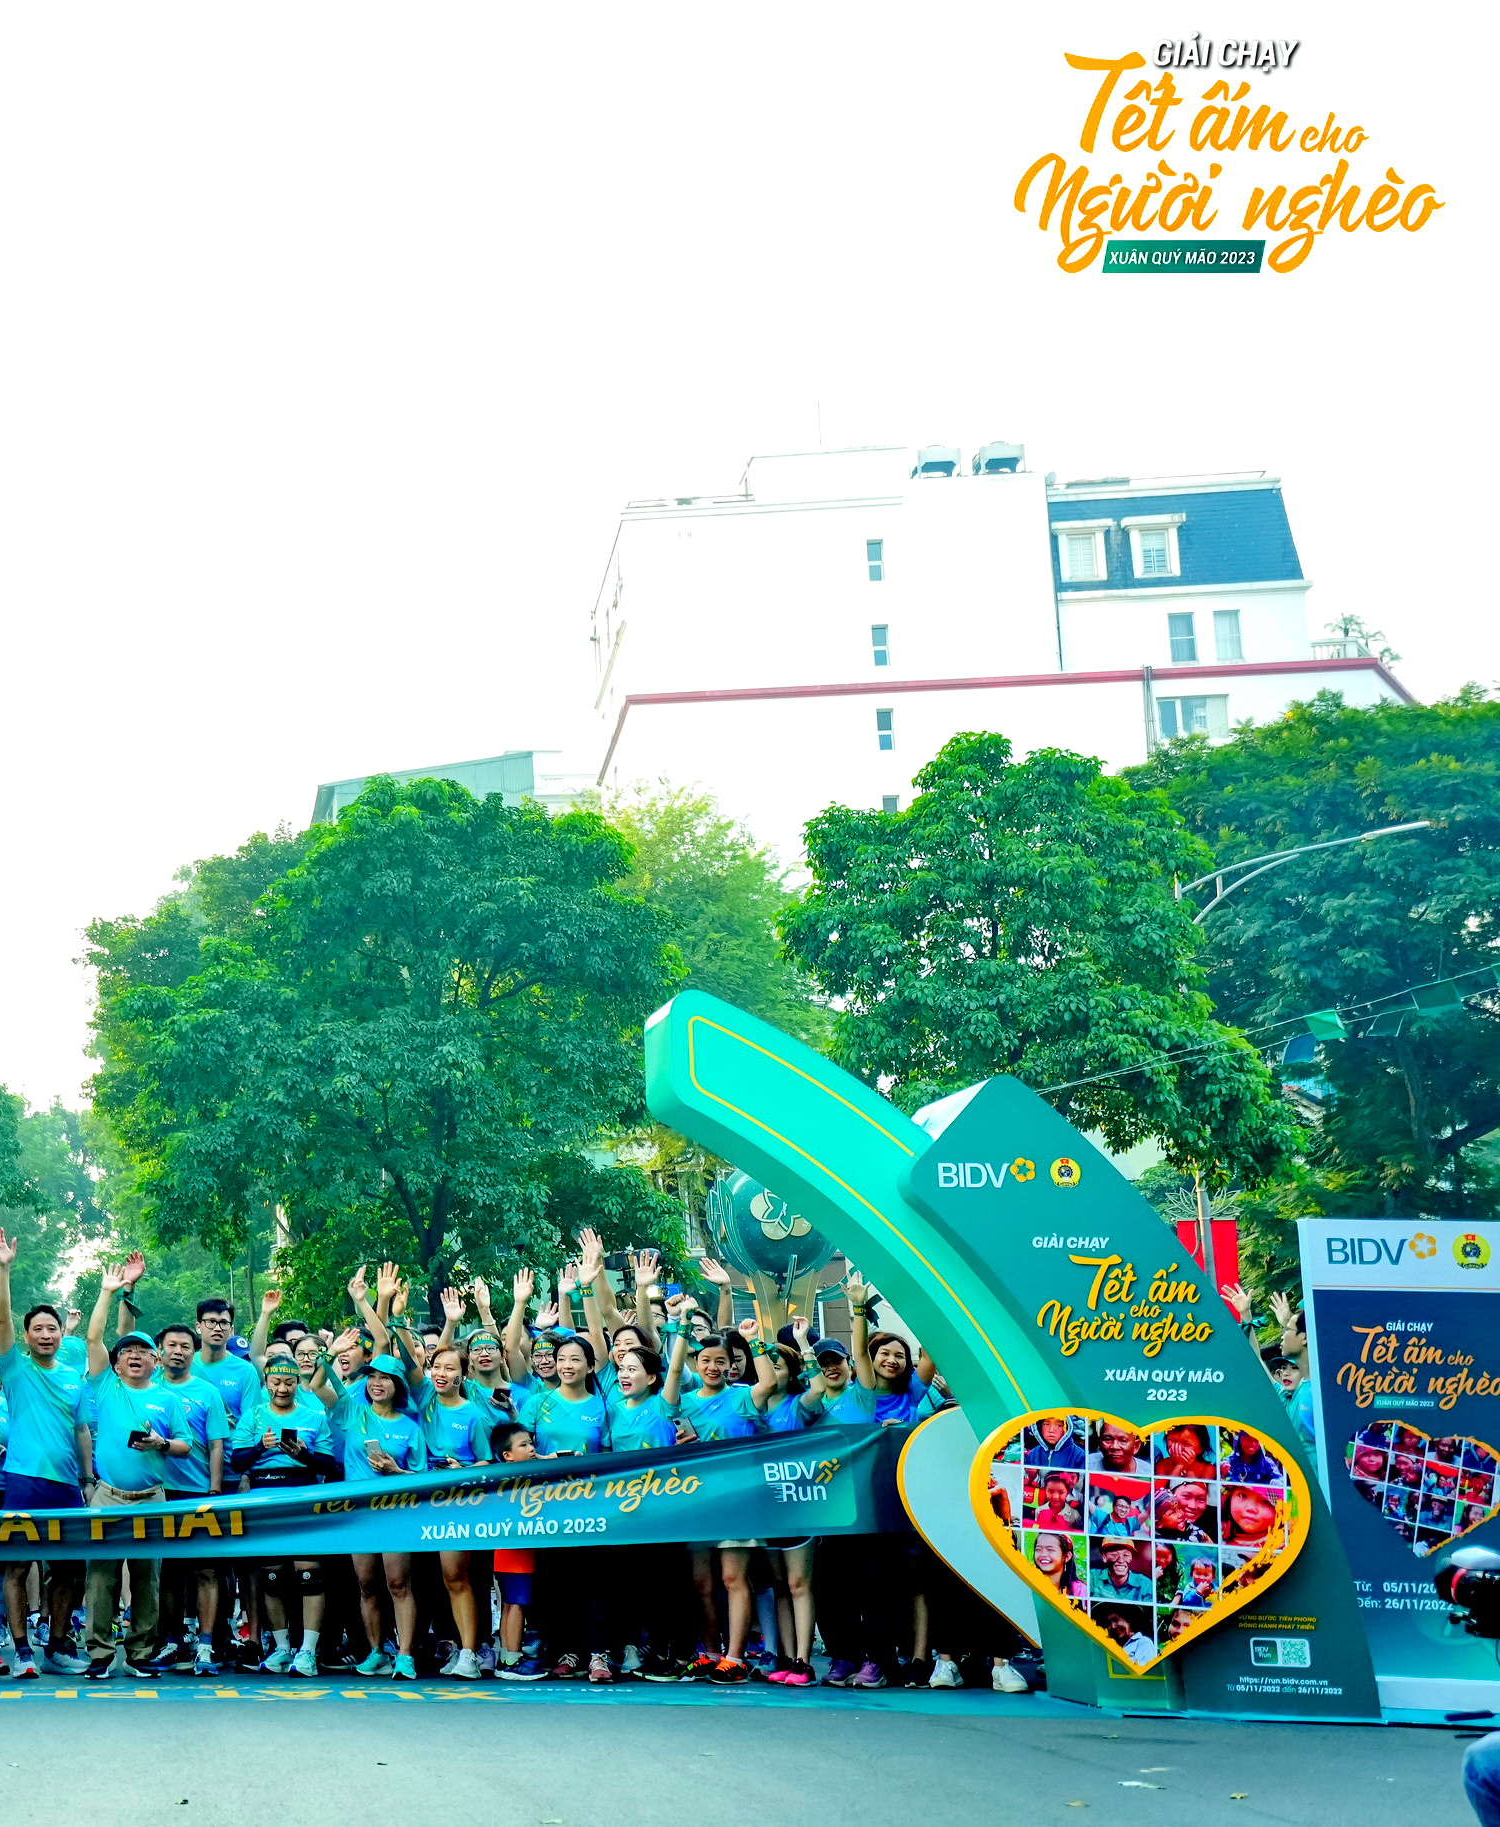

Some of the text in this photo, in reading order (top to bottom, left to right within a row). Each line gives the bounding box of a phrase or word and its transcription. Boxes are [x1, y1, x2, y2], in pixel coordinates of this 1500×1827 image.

[937, 1161, 1011, 1189] BIDV
[1031, 1232, 1110, 1252] GIẢI CHẠY
[1326, 1238, 1408, 1266] BIDV
[1068, 1254, 1200, 1311] Tết ấm
[1130, 1299, 1162, 1319] cho
[1036, 1299, 1213, 1358] Người nghèo
[1386, 1319, 1434, 1334] GIẢI CHẠY
[1351, 1325, 1475, 1367] Tết ấm cho
[1103, 1364, 1225, 1383] XUÂN QUÝ MÃO
[1146, 1389, 1188, 1402] 2023
[1336, 1362, 1500, 1411] Người nghèo
[1405, 1399, 1419, 1407] MÃO
[763, 1460, 818, 1482] BIDV
[497, 1473, 597, 1518] Người
[605, 1468, 703, 1514] nghèo
[772, 1482, 827, 1503] Run
[421, 1517, 607, 1540] XUÂN QUÝ MÃO 2023
[1382, 1582, 1437, 1594] 05/11/20
[1236, 1685, 1280, 1693] 05/11/2022
[1297, 1686, 1343, 1695] 26/11/2022
[1239, 1676, 1328, 1686] https://run.bidv.com.vn
